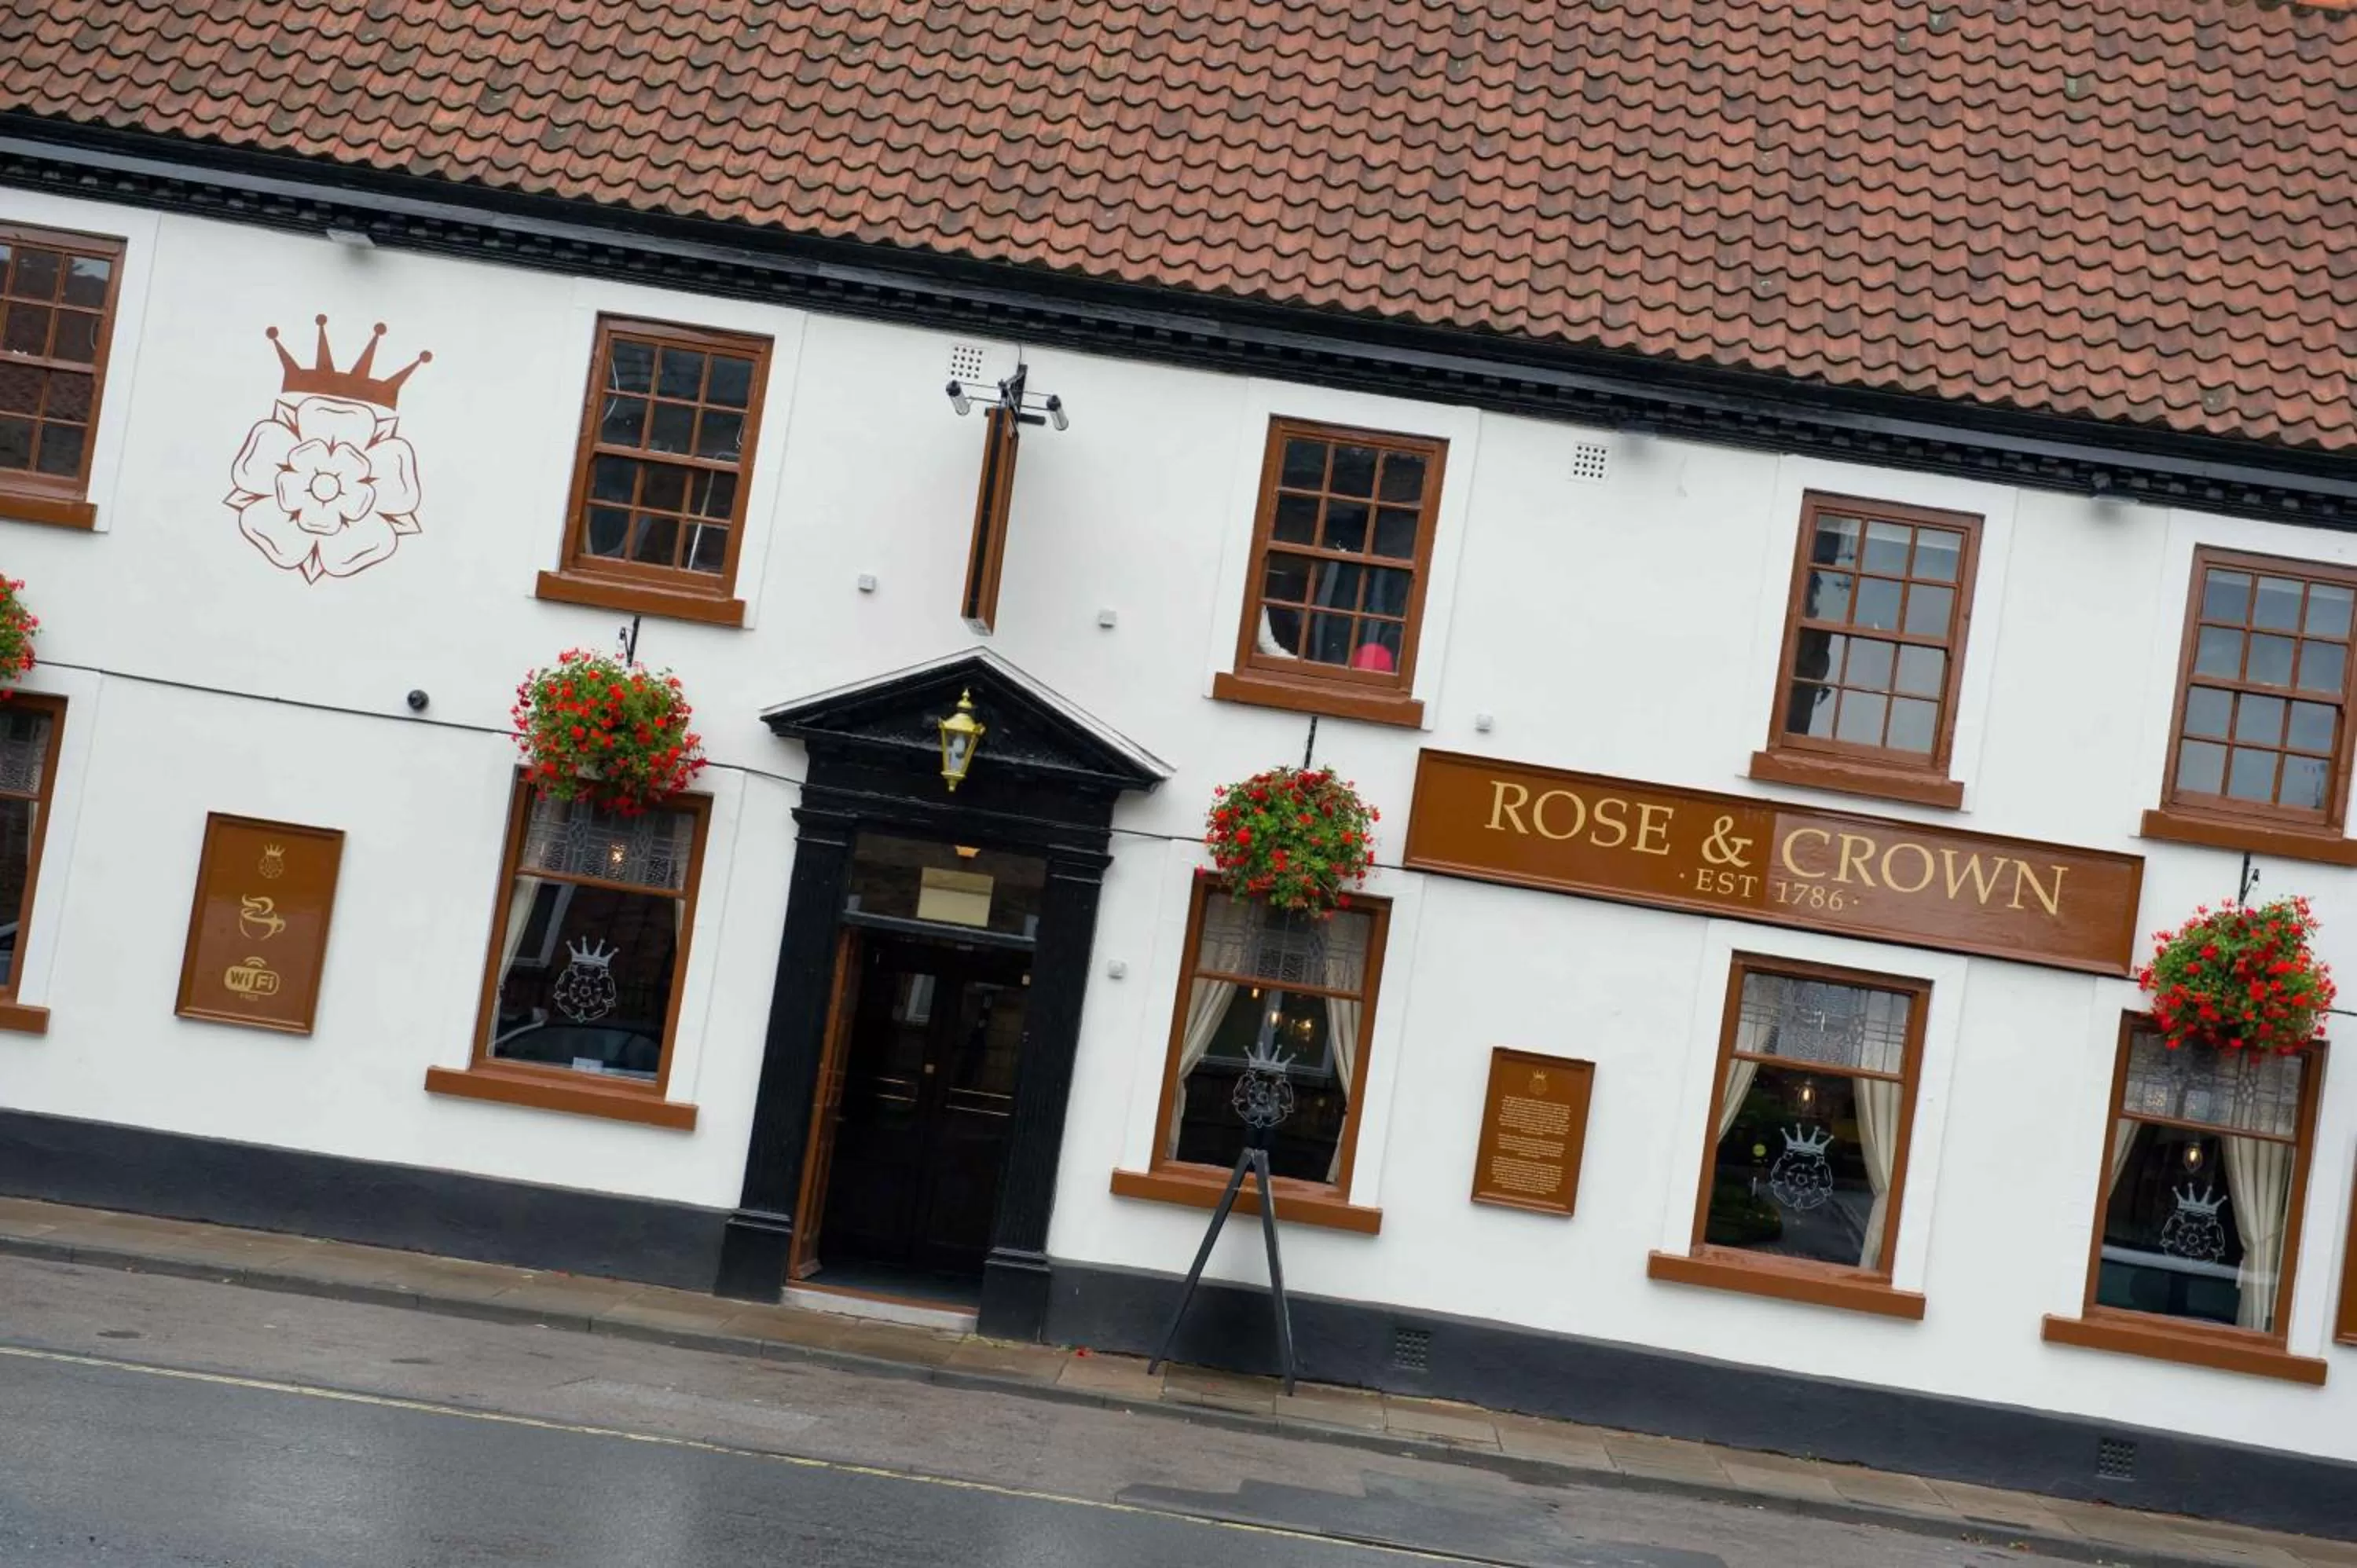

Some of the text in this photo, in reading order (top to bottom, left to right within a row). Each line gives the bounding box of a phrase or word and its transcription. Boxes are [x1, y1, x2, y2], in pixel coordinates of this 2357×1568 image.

[1485, 780, 2069, 916] ROSE & CROWN
[1695, 868, 1844, 910] EST 1786
